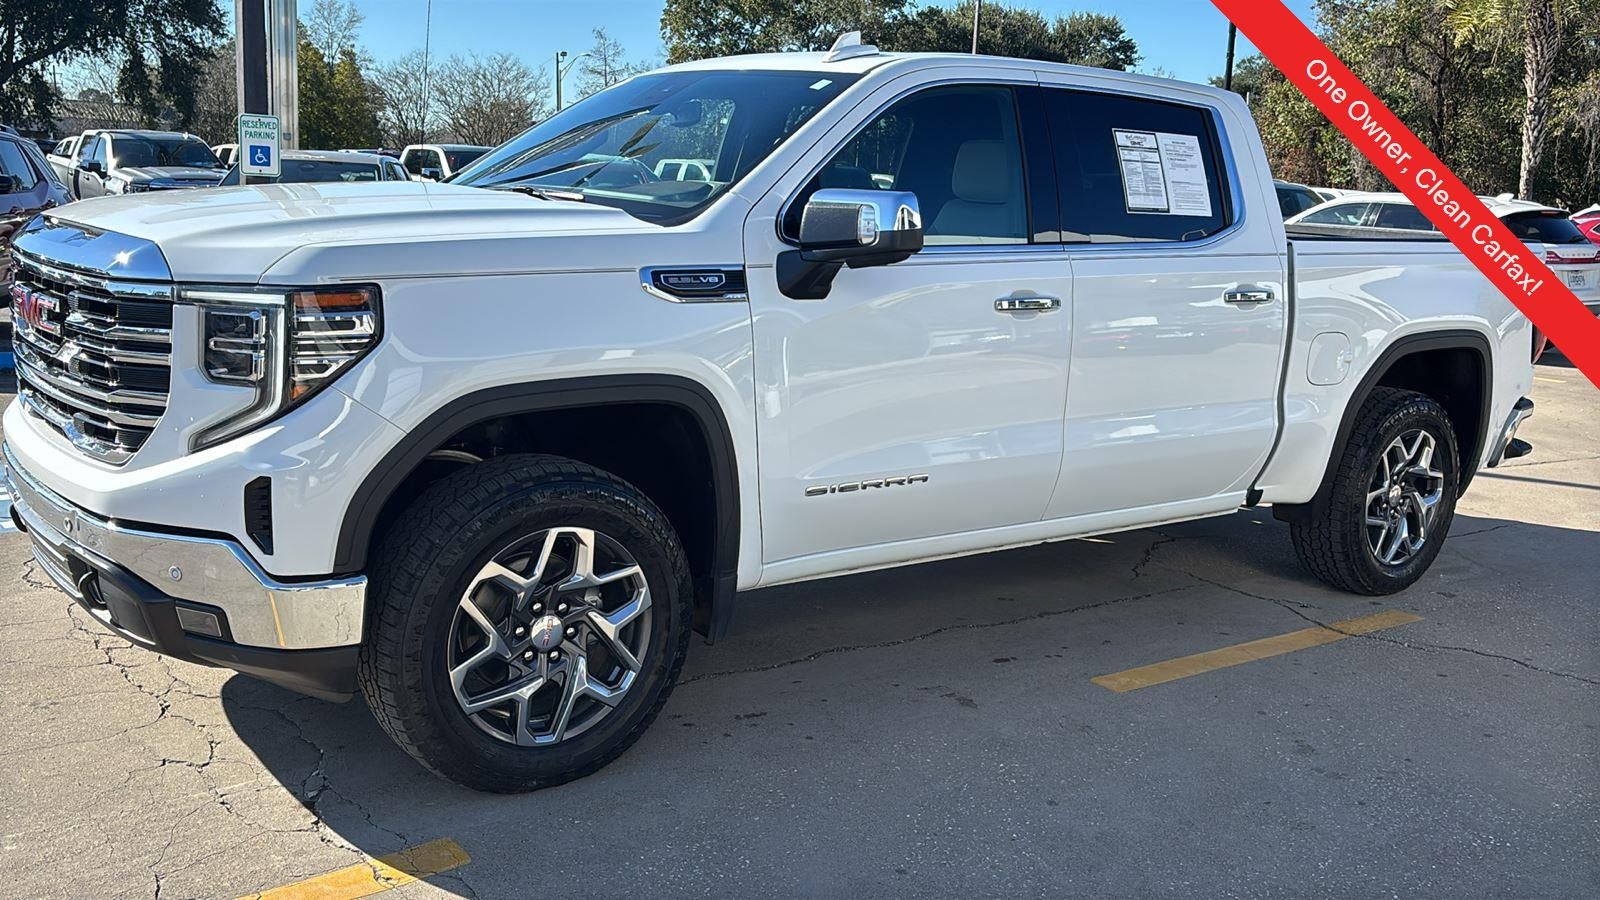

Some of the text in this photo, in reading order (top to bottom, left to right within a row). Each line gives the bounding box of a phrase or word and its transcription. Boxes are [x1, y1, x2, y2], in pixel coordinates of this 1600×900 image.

[242, 120, 277, 129] RESERVED
[245, 130, 275, 140] PARKING
[805, 473, 929, 497] SIERRA
